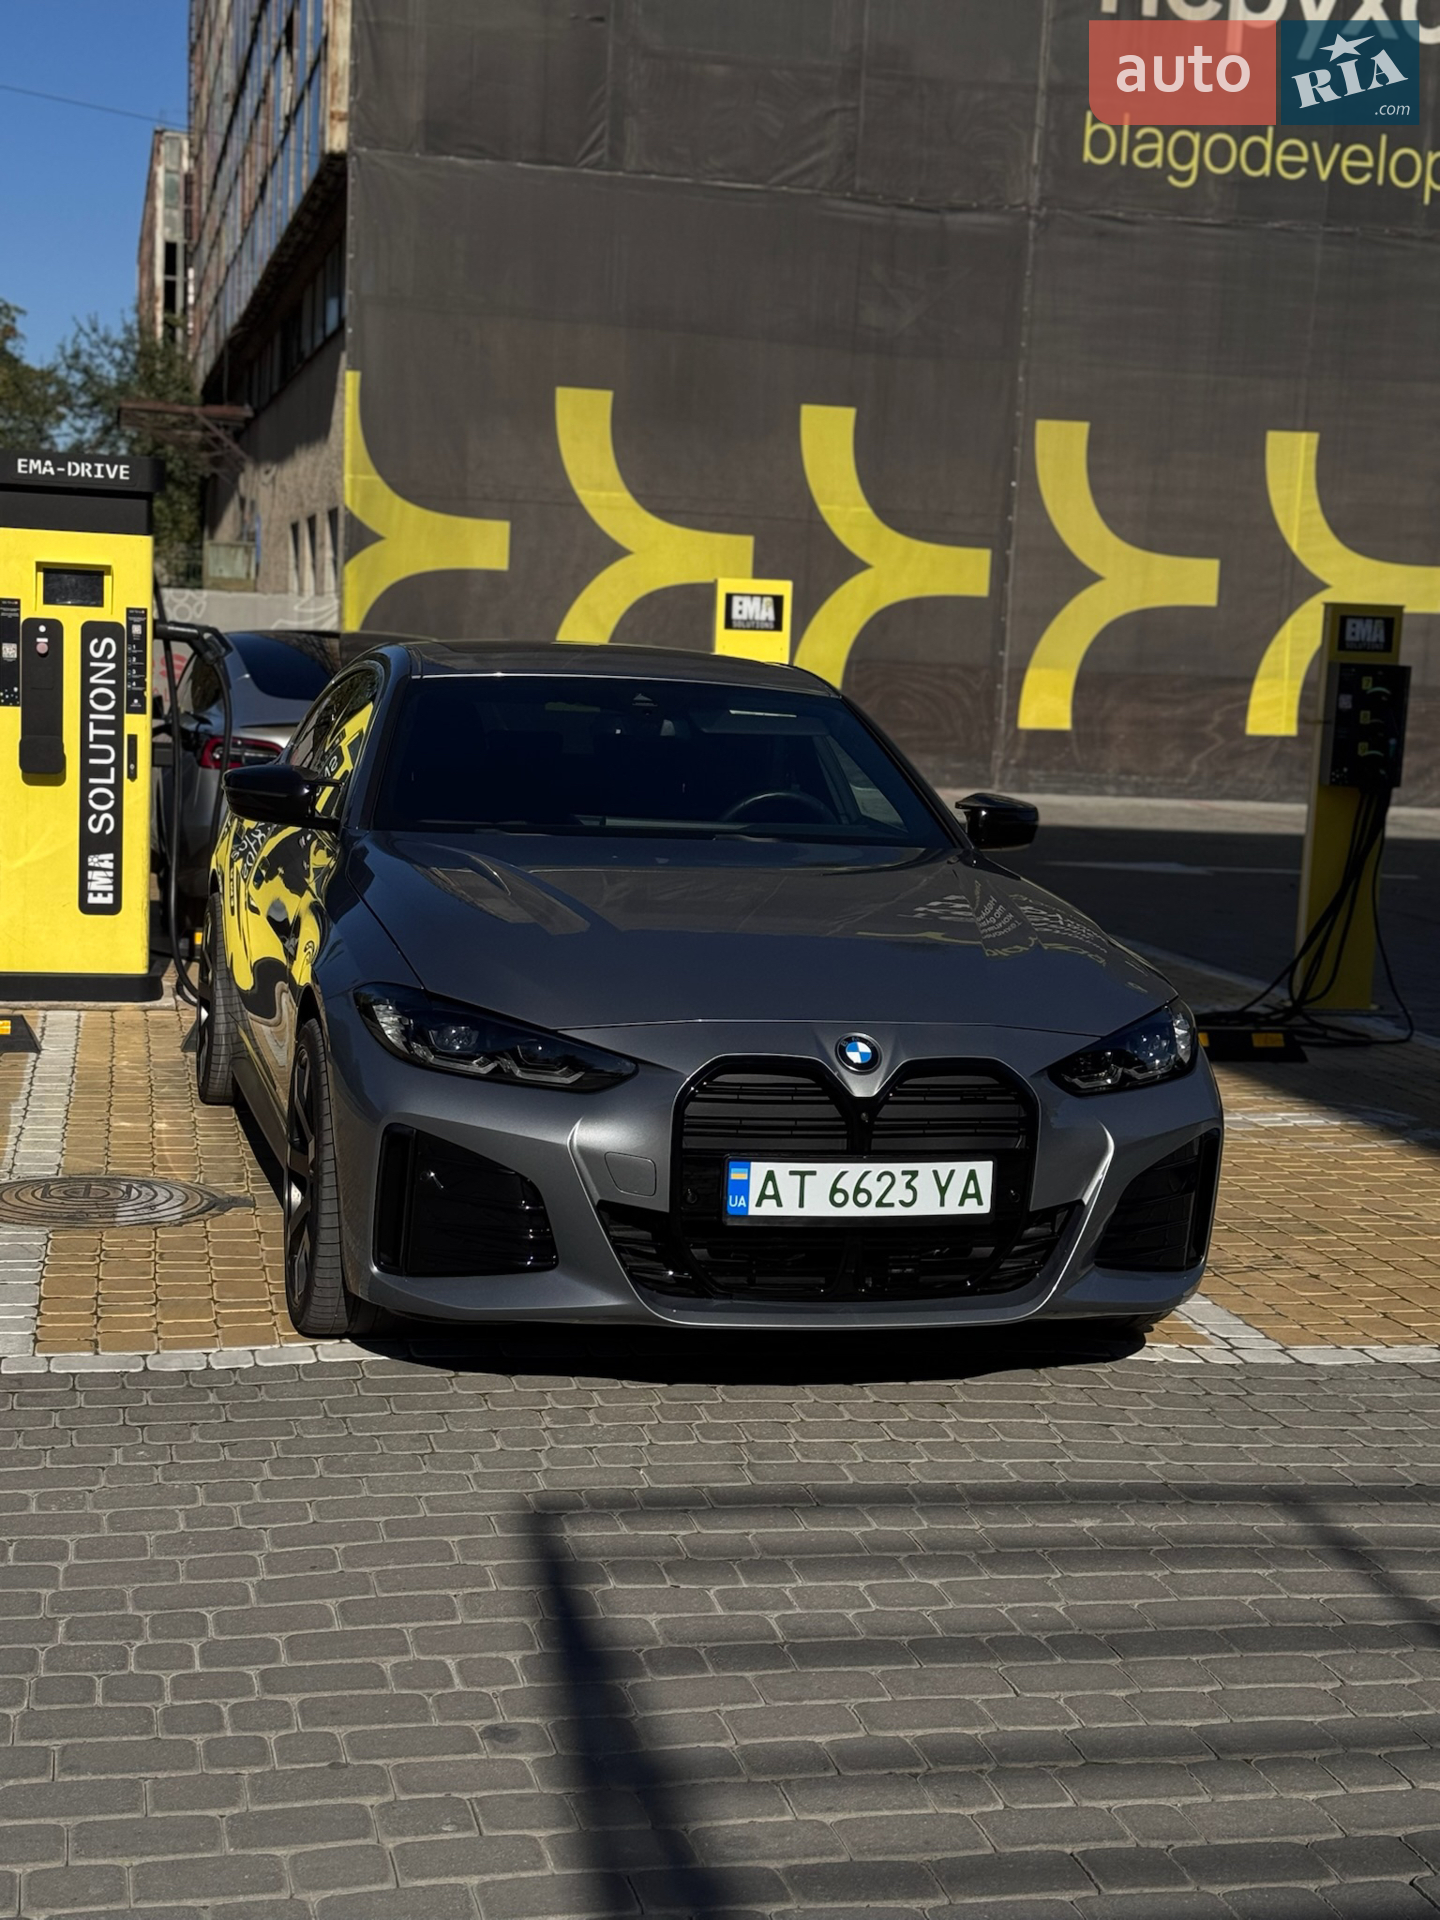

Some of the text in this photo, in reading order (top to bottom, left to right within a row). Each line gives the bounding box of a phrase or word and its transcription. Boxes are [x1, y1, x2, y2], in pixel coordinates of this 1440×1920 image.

[17, 458, 131, 481] EMA-DRIVE
[731, 595, 776, 621] EMA
[1345, 617, 1386, 643] EMA
[87, 636, 117, 906] EMA SOLUTIONS
[755, 1168, 984, 1208] AT 6623 YA
[728, 1195, 747, 1208] UA
